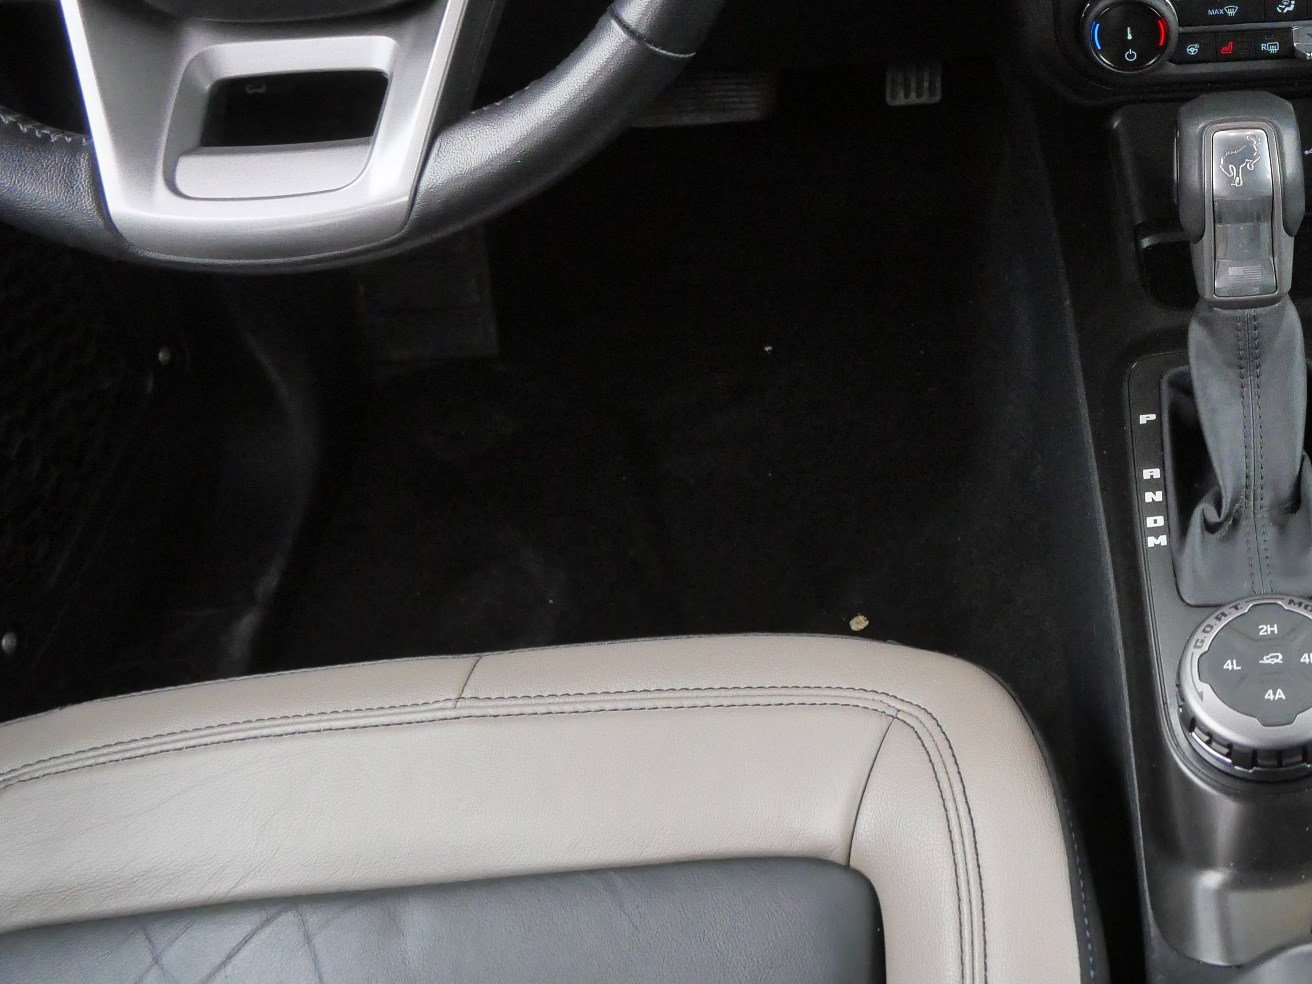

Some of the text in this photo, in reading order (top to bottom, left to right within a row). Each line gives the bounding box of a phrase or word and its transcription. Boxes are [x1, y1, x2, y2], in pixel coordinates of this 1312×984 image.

[1207, 7, 1224, 16] MAX
[1139, 413, 1157, 425] P
[1144, 490, 1163, 503] N
[1146, 515, 1165, 528] D
[1147, 534, 1168, 548] M
[1258, 624, 1278, 636] 2H
[1223, 659, 1242, 671] 4L
[1264, 689, 1286, 701] 4A
